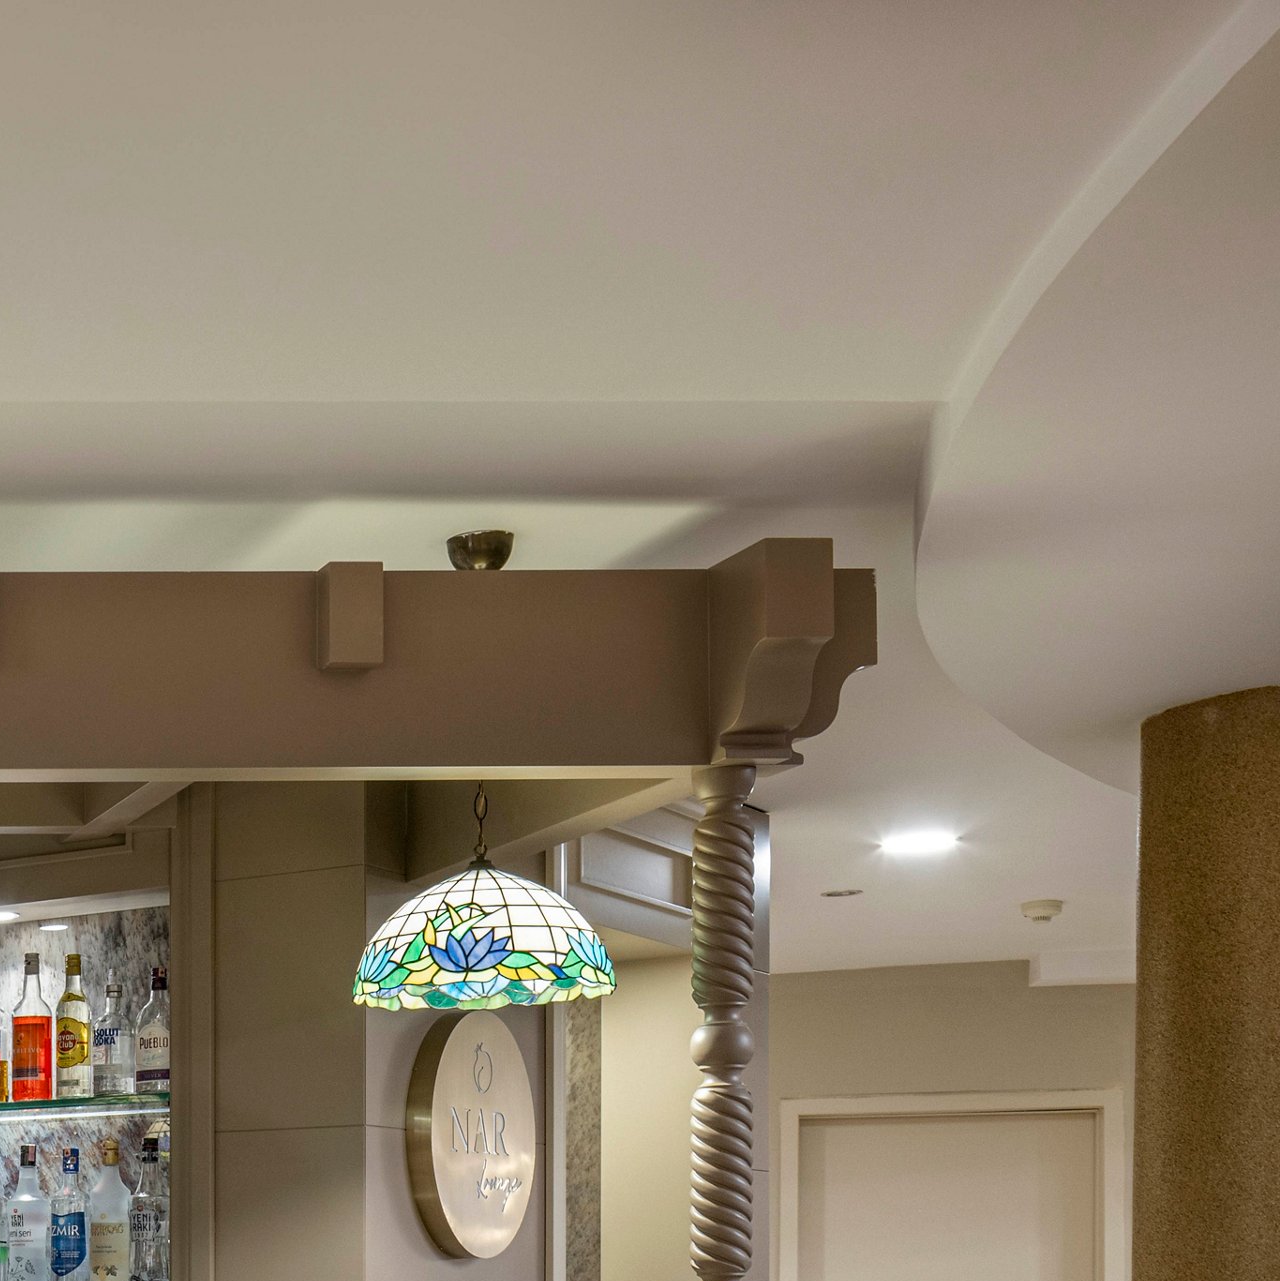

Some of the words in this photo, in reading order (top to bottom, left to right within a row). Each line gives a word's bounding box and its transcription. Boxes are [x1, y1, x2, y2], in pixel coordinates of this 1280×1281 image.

[58, 1033, 79, 1042] avana
[93, 1027, 119, 1038] SOLUT
[58, 1040, 74, 1049] Club
[139, 1036, 169, 1050] PUEBLO
[450, 1106, 510, 1157] NAR
[476, 1158, 523, 1213] Lounge
[51, 1224, 80, 1237] ZMİR
[132, 1222, 151, 1232] RAKI
